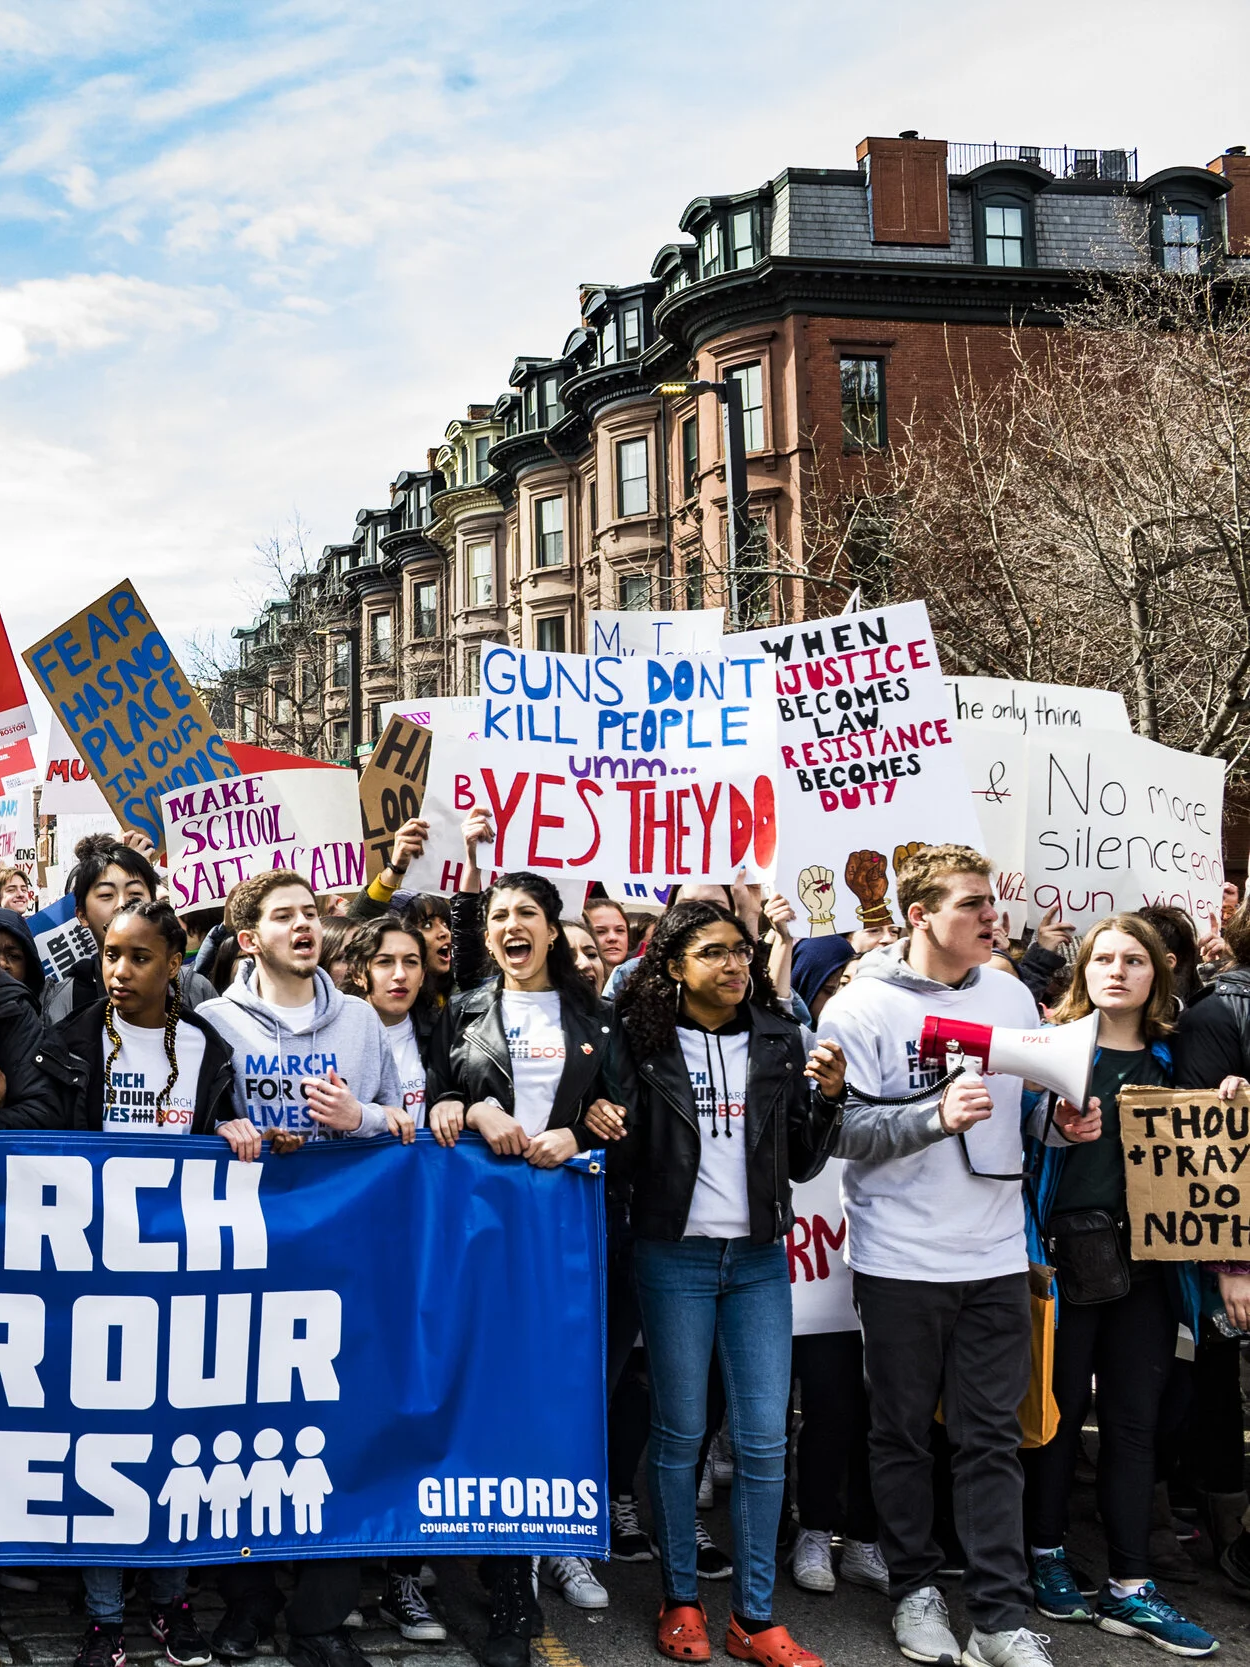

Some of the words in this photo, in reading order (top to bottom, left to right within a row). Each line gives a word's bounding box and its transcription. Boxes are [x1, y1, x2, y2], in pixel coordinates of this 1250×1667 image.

[31, 590, 147, 693] FEAR
[761, 616, 888, 663] WHEN
[59, 664, 124, 732] HAS
[116, 631, 172, 694] NO
[484, 648, 623, 706] GUNS
[647, 655, 766, 706] DON'T
[776, 639, 930, 696] JUSTICE
[81, 667, 191, 777] PLACE
[777, 677, 910, 722] BECOMES
[813, 707, 884, 738] LAW,
[992, 689, 1027, 735] only
[0, 724, 26, 737] BOSTON
[485, 699, 578, 745] KILL
[598, 705, 750, 752] PEOPLE
[781, 718, 952, 769] RESISTANCE
[105, 758, 148, 803] IN
[148, 714, 202, 769] OUR
[797, 753, 921, 792] BECOMES
[166, 776, 265, 824] MAKE
[819, 778, 898, 812] DUTY
[1048, 753, 1127, 816] No
[1148, 785, 1211, 835] more
[181, 804, 296, 859] SCHOOL
[480, 768, 604, 870] YES
[616, 781, 722, 875] THEY
[729, 774, 777, 869] DO
[1034, 885, 1114, 923] gun
[1022, 1035, 1051, 1044] PYLE
[111, 1072, 145, 1088] RCH
[245, 1053, 338, 1076] MARCH
[120, 1090, 155, 1106] OUR
[245, 1079, 296, 1100] FOR
[1189, 1182, 1241, 1208] DO
[70, 1289, 343, 1411] OUR
[418, 1476, 598, 1519] GIFFORDS
[420, 1522, 470, 1533] COURAGE
[471, 1522, 485, 1533] TO
[488, 1522, 519, 1533] FIGHT
[522, 1523, 544, 1534] GUN
[546, 1523, 598, 1536] VIOLENCE
